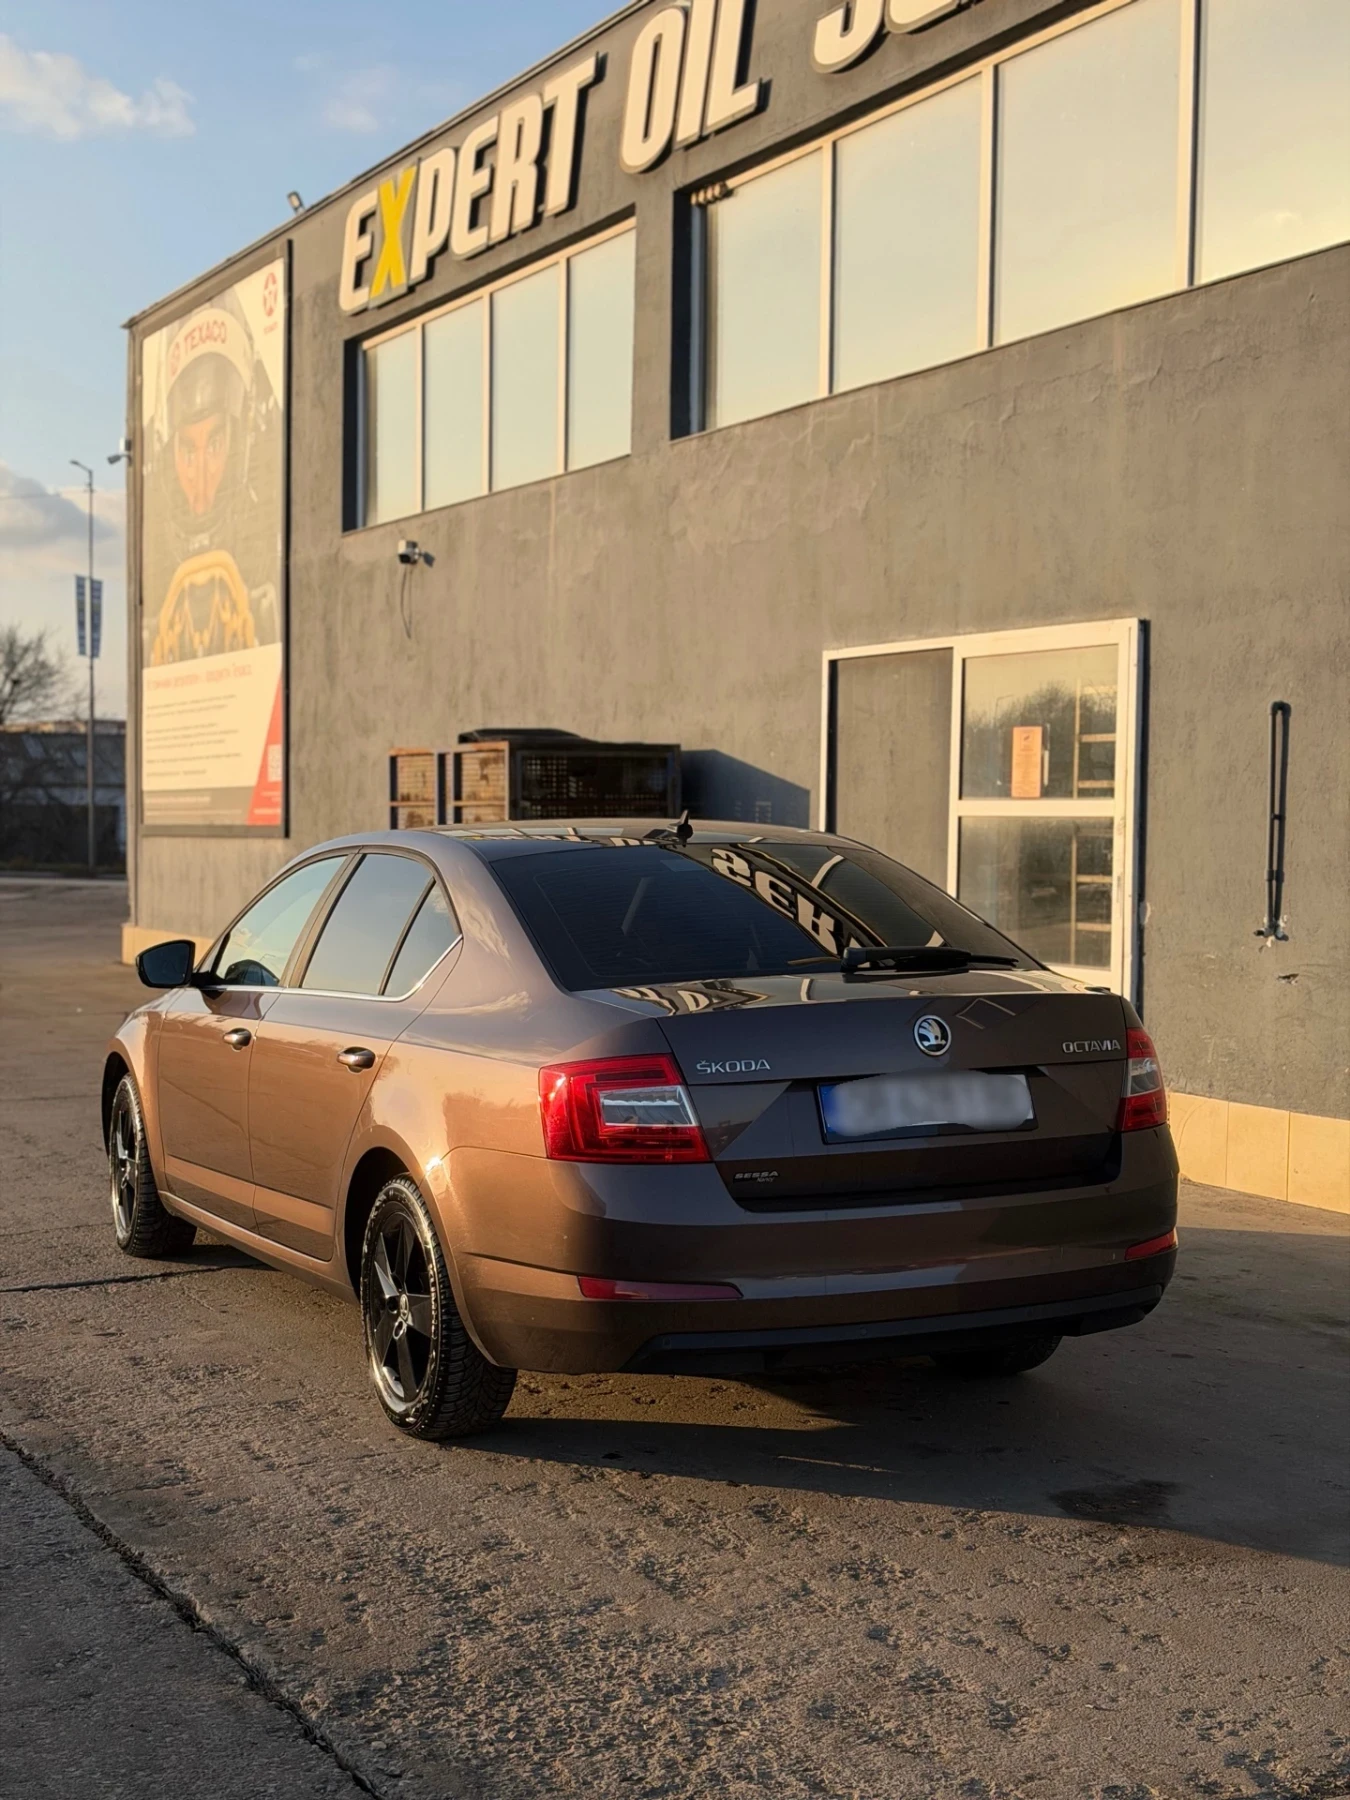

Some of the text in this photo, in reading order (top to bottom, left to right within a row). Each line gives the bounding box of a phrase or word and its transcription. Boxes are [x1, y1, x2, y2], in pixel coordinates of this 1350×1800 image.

[339, 0, 760, 314] EXPERT OIL
[185, 320, 226, 354] TEXACO
[1062, 1039, 1121, 1053] OCTAVIA
[696, 1059, 771, 1075] ŠKODA
